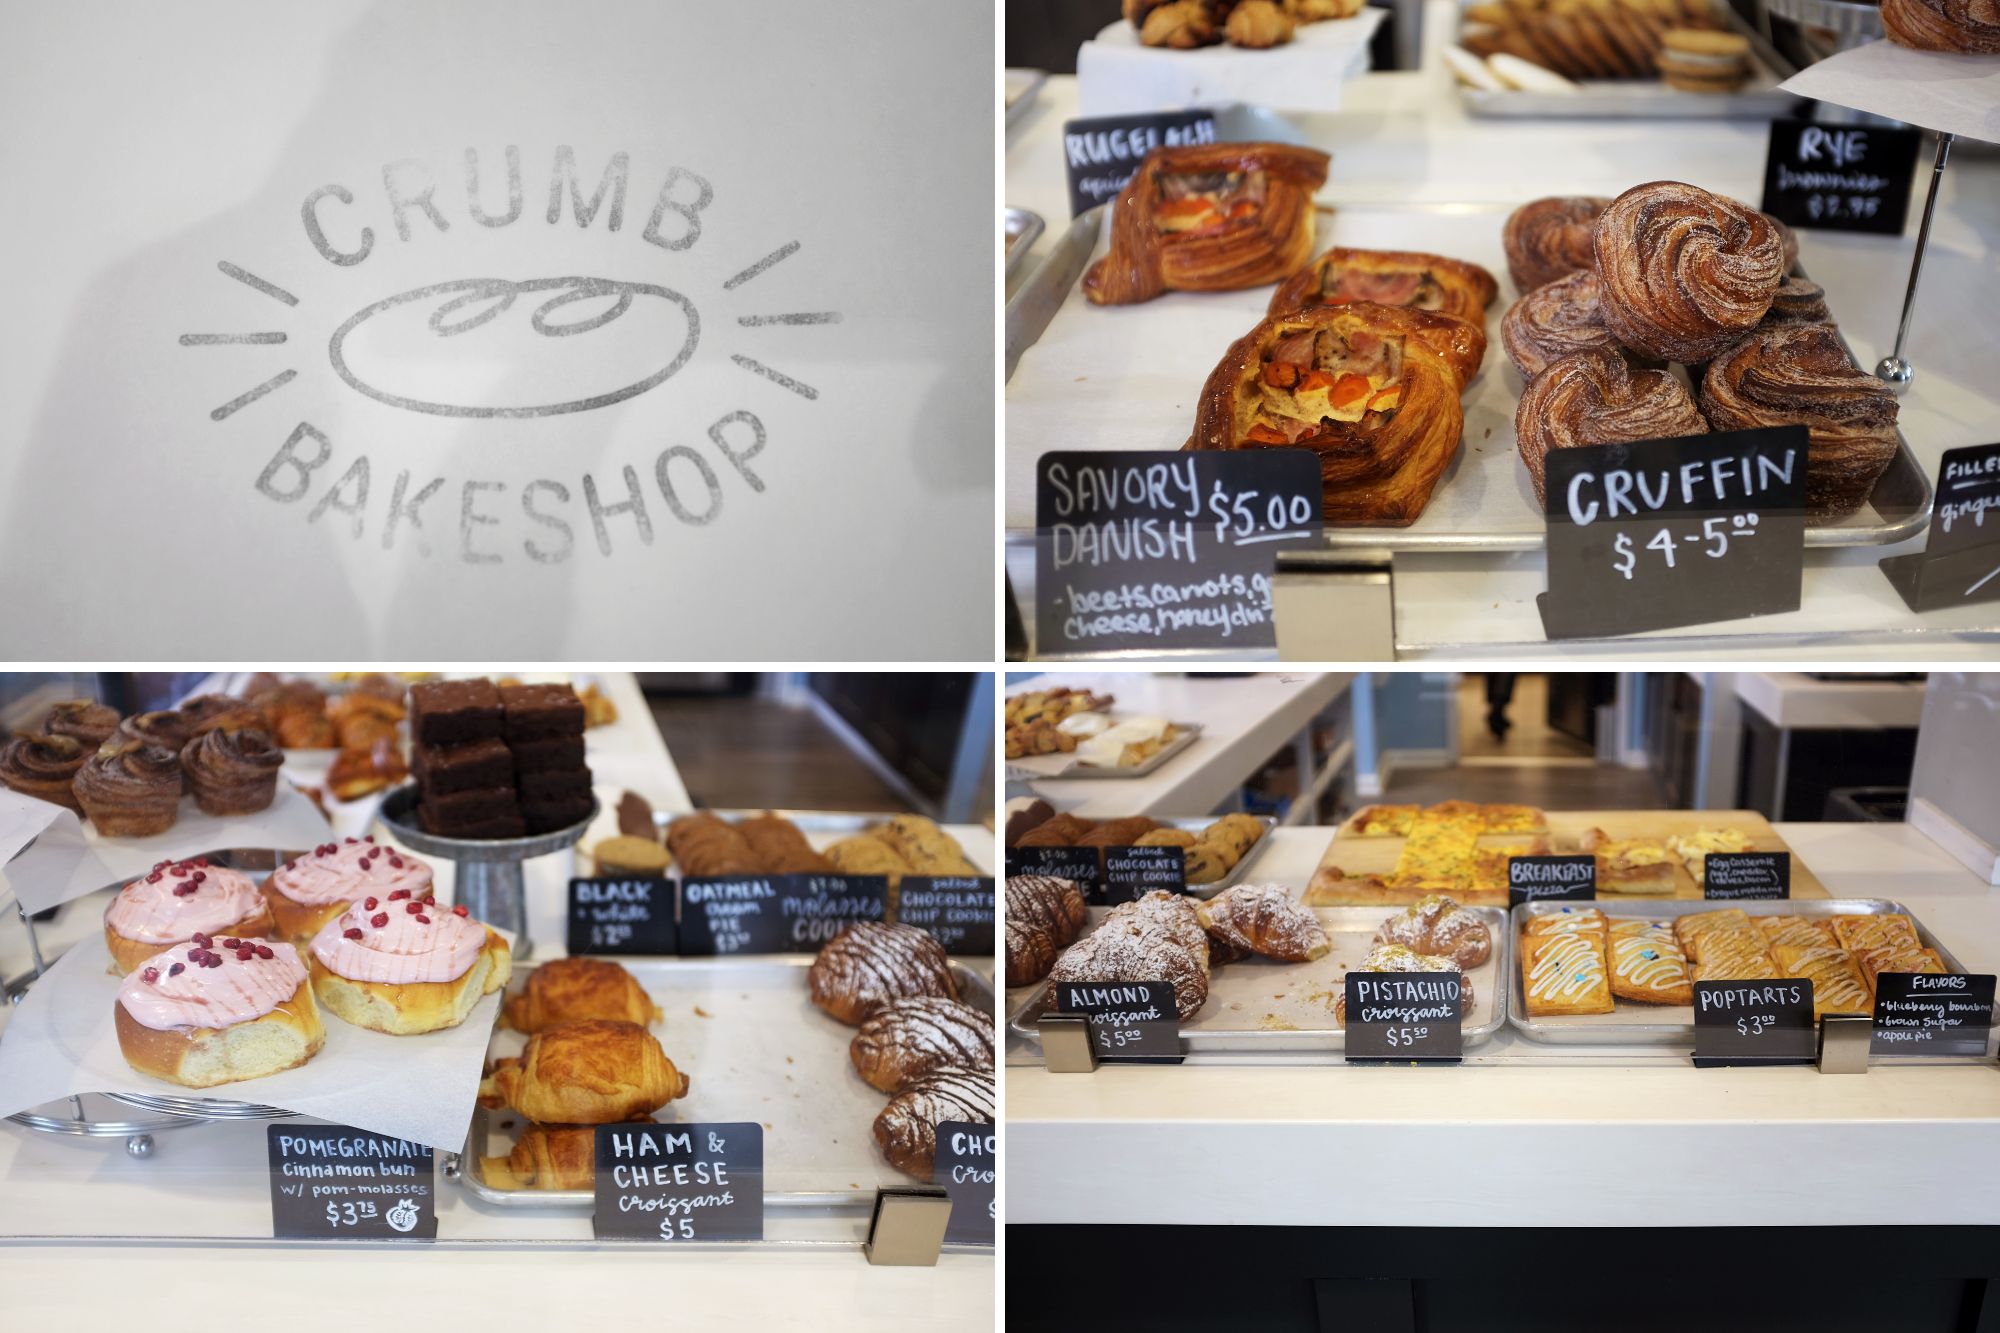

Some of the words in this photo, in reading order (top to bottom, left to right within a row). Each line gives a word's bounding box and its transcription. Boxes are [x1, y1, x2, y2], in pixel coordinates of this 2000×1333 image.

[1798, 126, 1869, 166] RYE
[301, 145, 713, 267] CRUMB
[254, 410, 767, 565] BAKESHOP
[1567, 449, 1796, 526] CRUFFIN
[1048, 457, 1199, 518] SAVORY
[1208, 479, 1312, 545] $5.00
[1052, 517, 1196, 570] DANISH
[1107, 858, 1179, 871] CHOCOLATE
[1511, 862, 1594, 883] BREAKFAST
[1109, 871, 1137, 882] CHIP
[1143, 871, 1181, 882] COOKIE
[576, 881, 653, 902] BLACK
[686, 879, 777, 904] OATMEAL
[901, 907, 940, 923] CHIP
[1357, 981, 1459, 1003] PISTACHIO
[1912, 976, 1967, 990] FLAVORS
[1070, 986, 1151, 1007] ALMOND
[1700, 986, 1801, 1011] POPTARTS
[1361, 1004, 1454, 1023] croissant
[1885, 1016, 1920, 1027] brown
[1914, 1028, 1933, 1042] pie
[612, 1132, 692, 1158] HAM
[708, 1131, 726, 1154] &
[379, 1162, 416, 1177] bun
[613, 1161, 729, 1189] CHEESE
[619, 1191, 734, 1216] croissant
